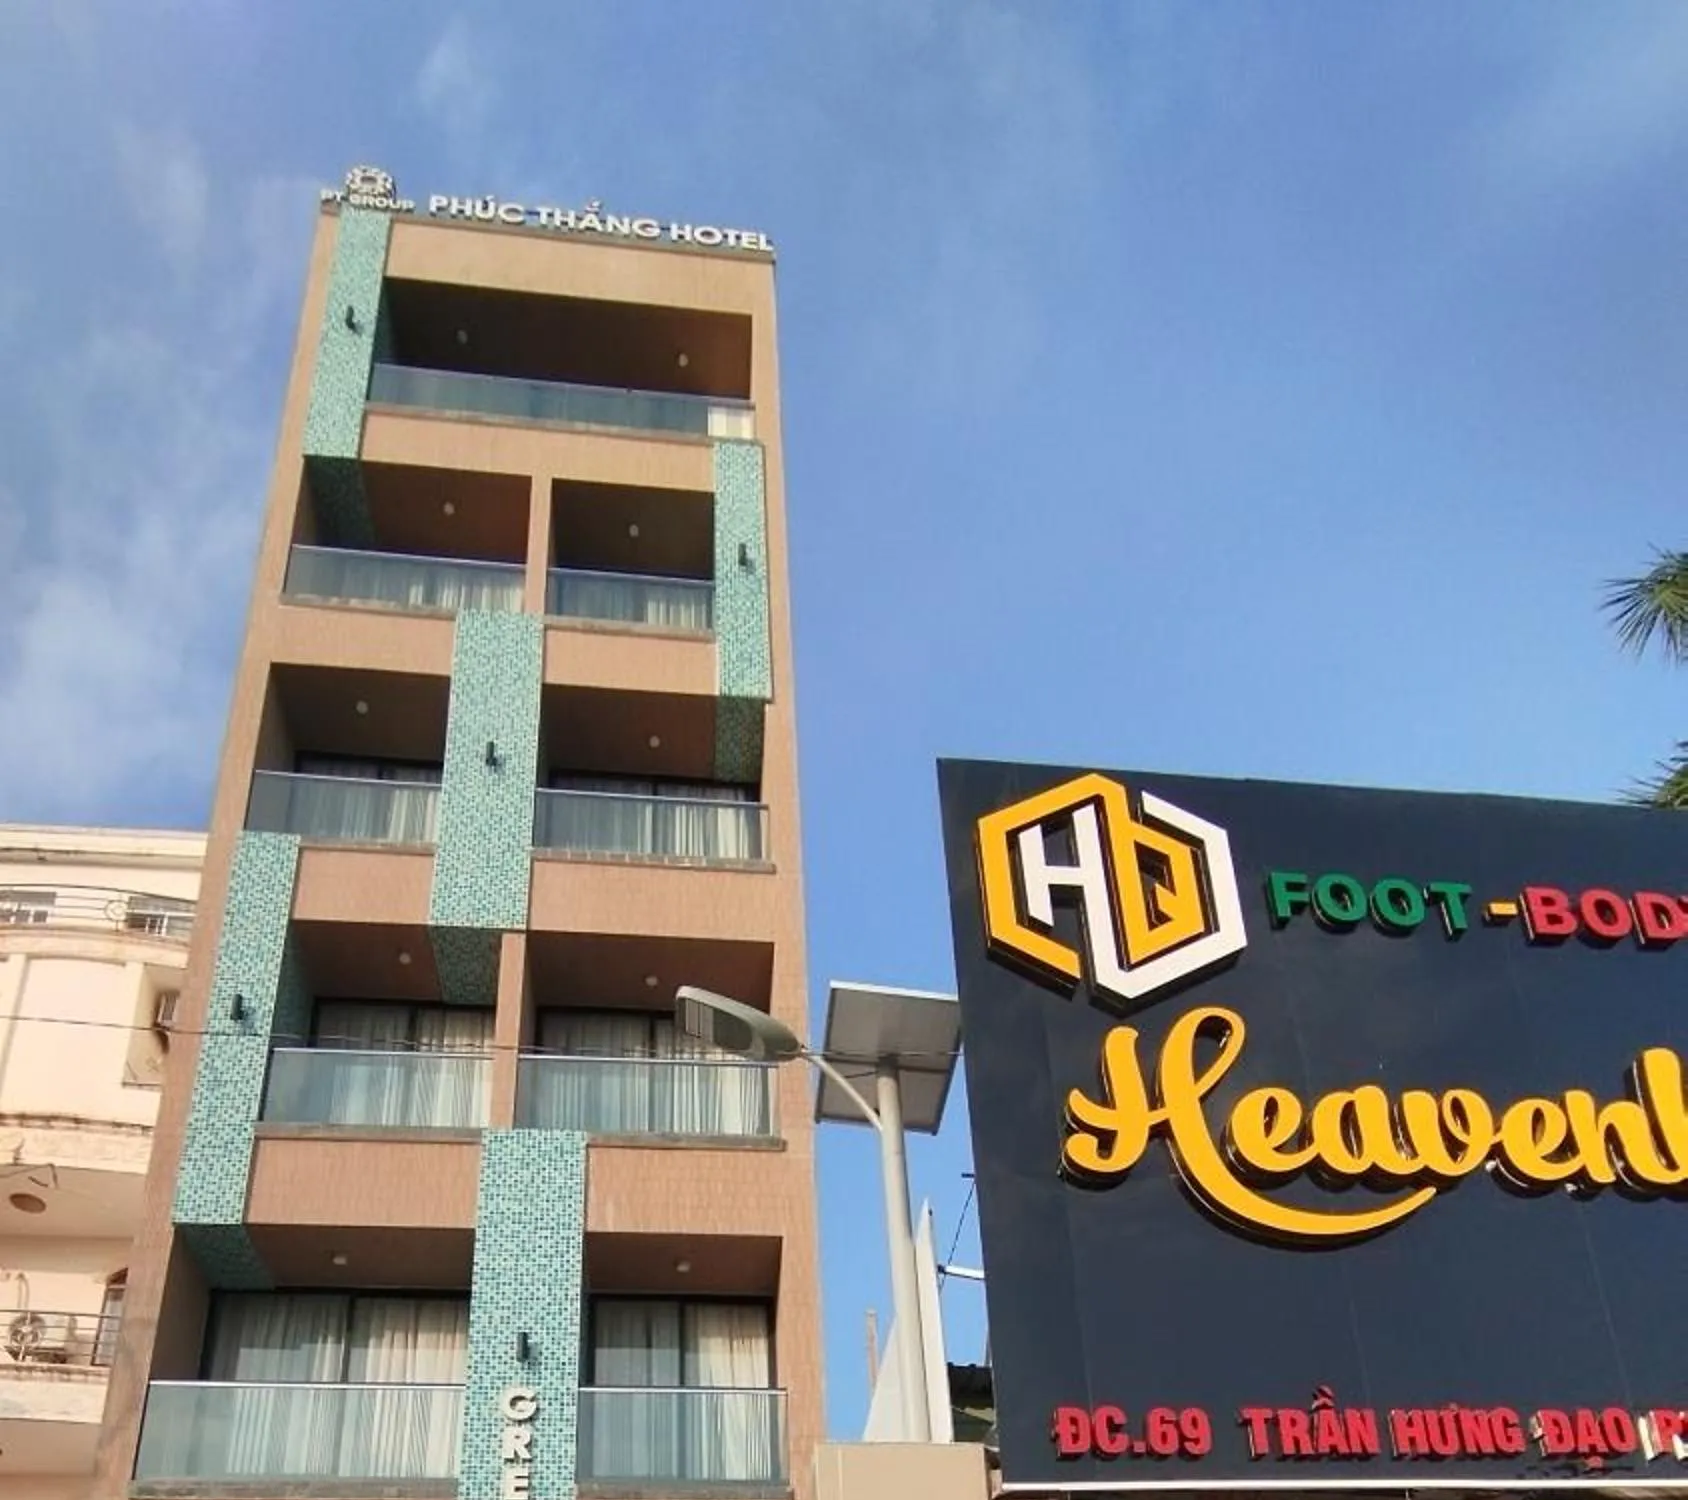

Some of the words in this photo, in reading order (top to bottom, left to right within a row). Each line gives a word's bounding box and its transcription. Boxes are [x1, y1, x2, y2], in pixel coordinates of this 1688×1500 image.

[349, 193, 416, 211] GROUP
[428, 194, 525, 224] PHÚC
[669, 222, 774, 251] HOTEL
[1063, 1006, 1688, 1235] Heavenl
[1239, 1385, 1381, 1457] TRẦN
[1391, 1402, 1527, 1456] HƯNG
[1534, 1406, 1637, 1470] ĐẠO
